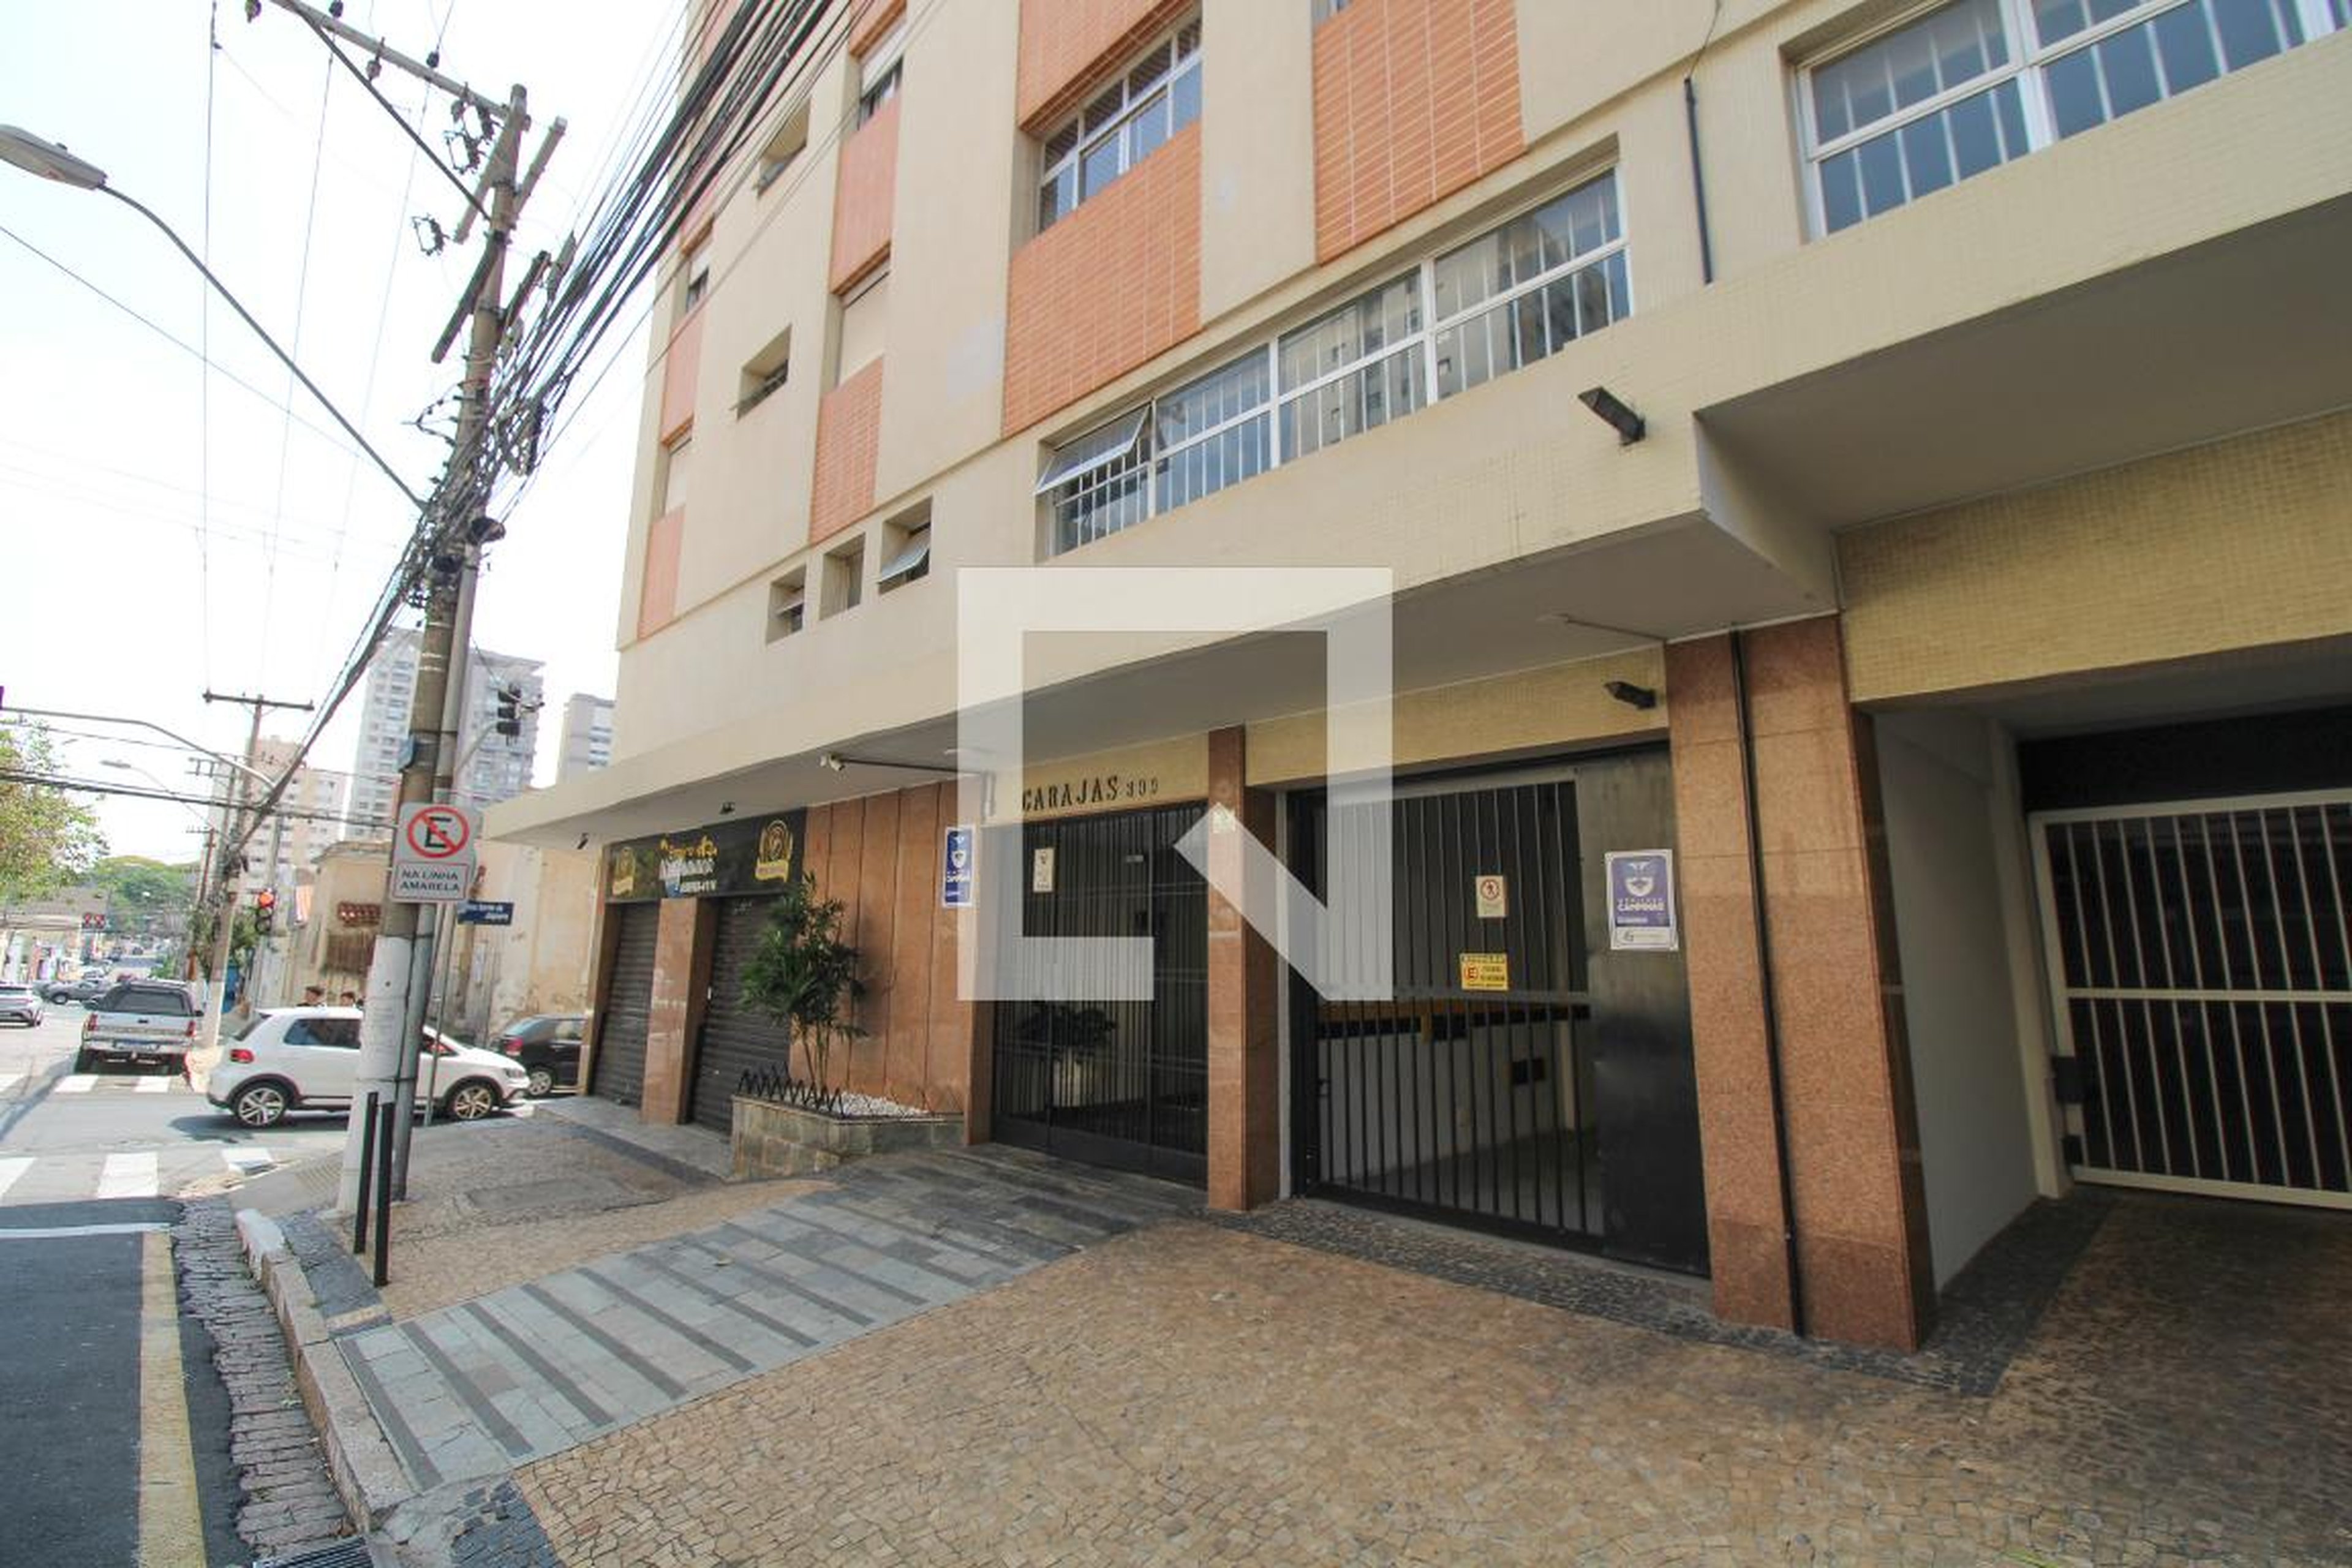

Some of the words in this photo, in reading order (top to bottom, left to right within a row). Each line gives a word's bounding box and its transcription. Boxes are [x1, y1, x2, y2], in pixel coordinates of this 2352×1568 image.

[1022, 775, 1117, 812] CARAJAS
[402, 869, 420, 879] NA
[401, 881, 459, 891] AMARELA
